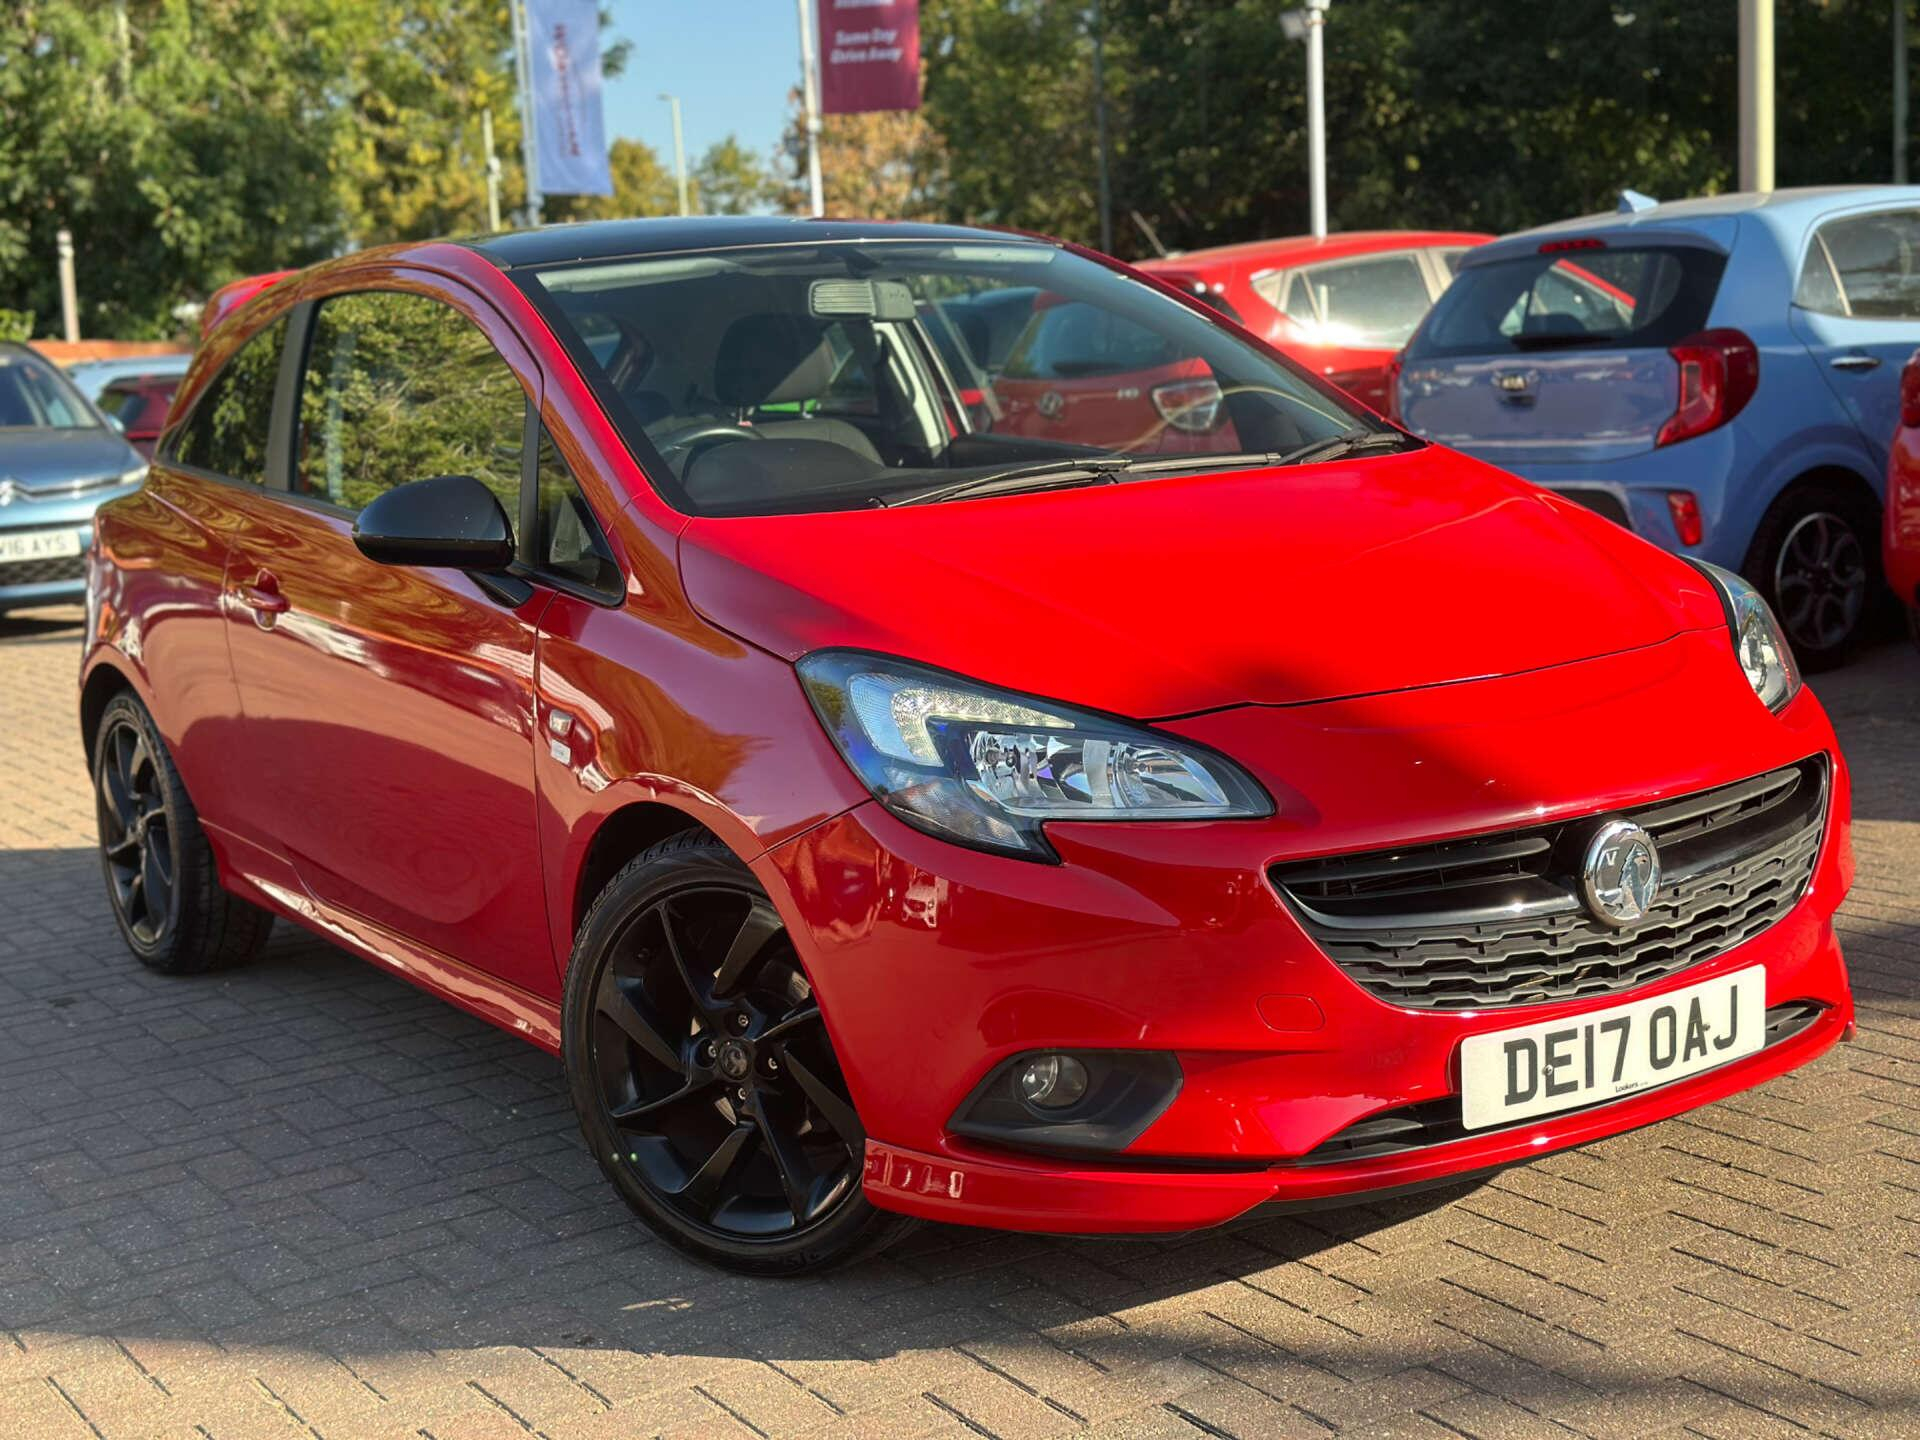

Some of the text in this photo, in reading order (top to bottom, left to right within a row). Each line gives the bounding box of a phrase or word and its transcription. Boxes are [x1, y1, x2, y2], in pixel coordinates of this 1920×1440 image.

[836, 29, 897, 45] Same Day
[831, 48, 902, 63] Drive Away
[32, 534, 67, 553] AYS
[1504, 984, 1738, 1107] DE17 OAJ
